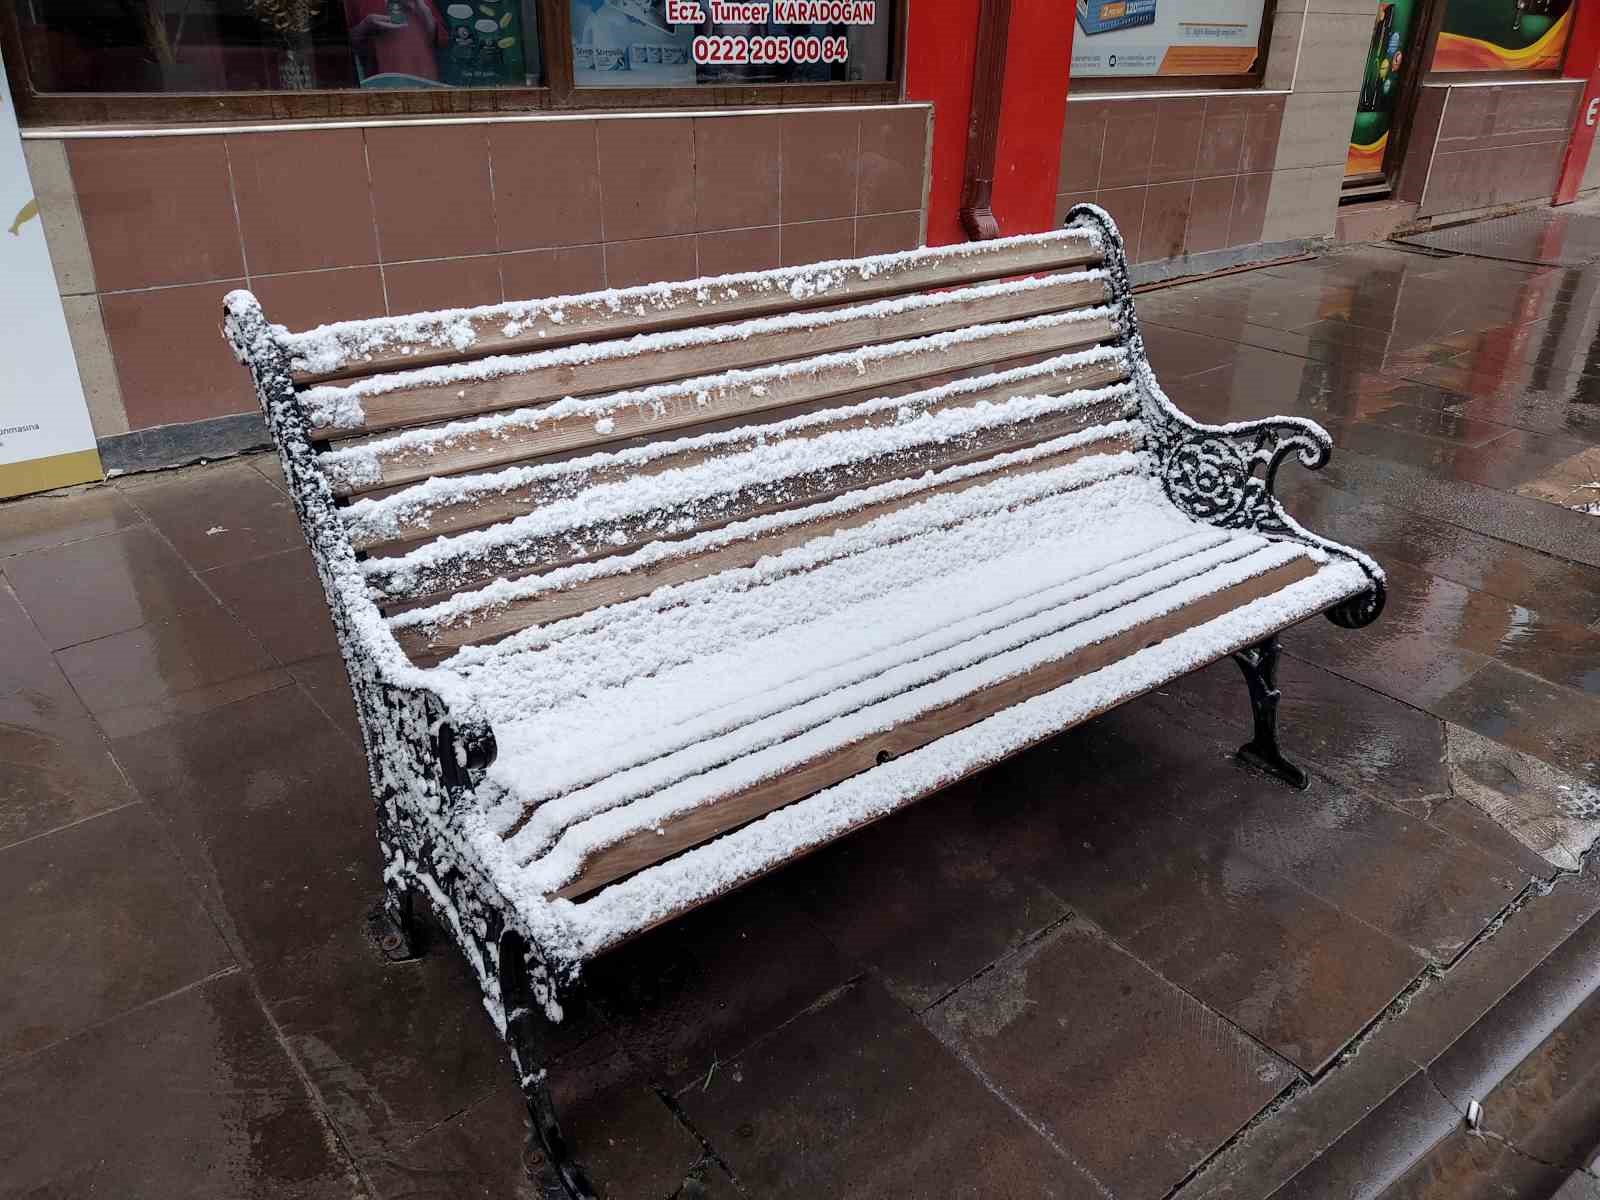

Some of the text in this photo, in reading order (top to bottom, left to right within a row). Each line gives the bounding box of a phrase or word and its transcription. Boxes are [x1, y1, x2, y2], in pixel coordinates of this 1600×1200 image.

[667, 0, 876, 24] Ecz. Tuncer KARADOĞAN
[693, 36, 848, 64] 0222 205 00 84
